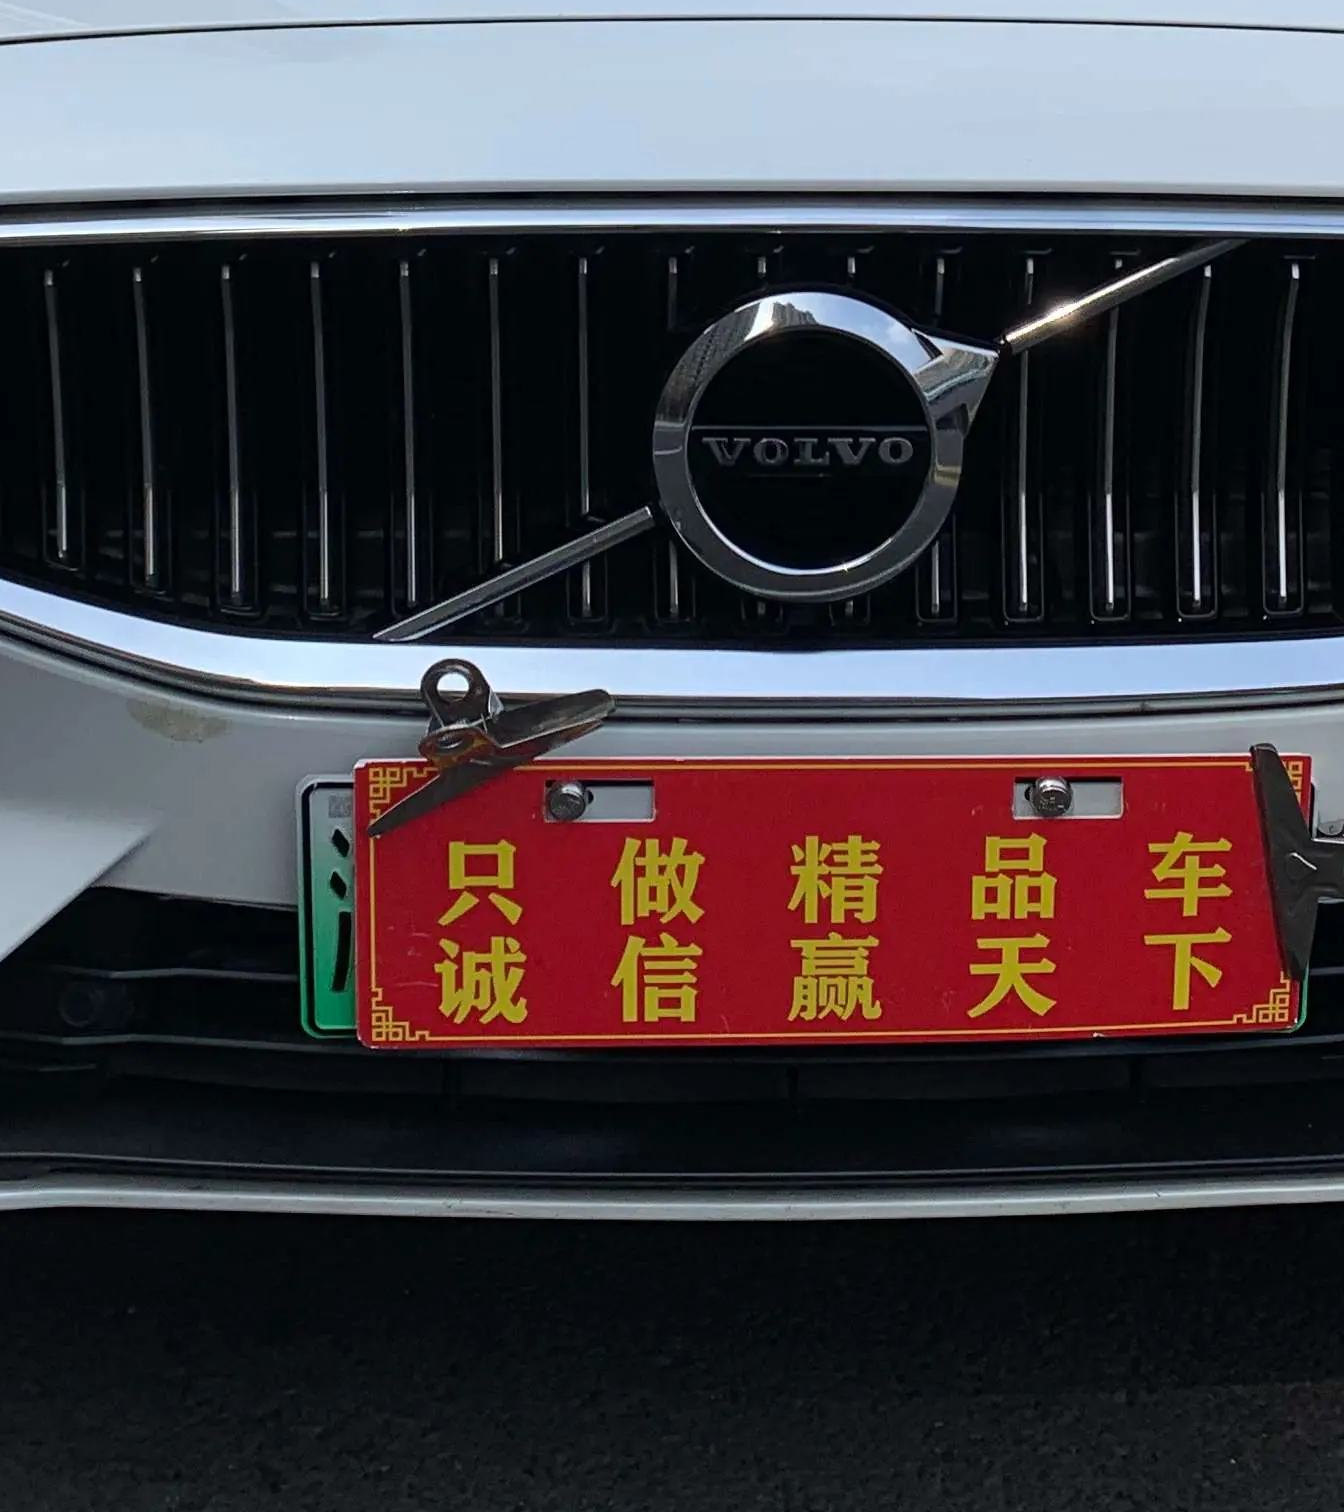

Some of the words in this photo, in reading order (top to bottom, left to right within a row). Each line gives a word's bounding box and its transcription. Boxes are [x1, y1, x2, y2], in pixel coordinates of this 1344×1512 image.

[702, 437, 914, 466] VOLVO
[438, 831, 1232, 924] 只做精品车
[435, 929, 1233, 1025] 诚信赢天下
